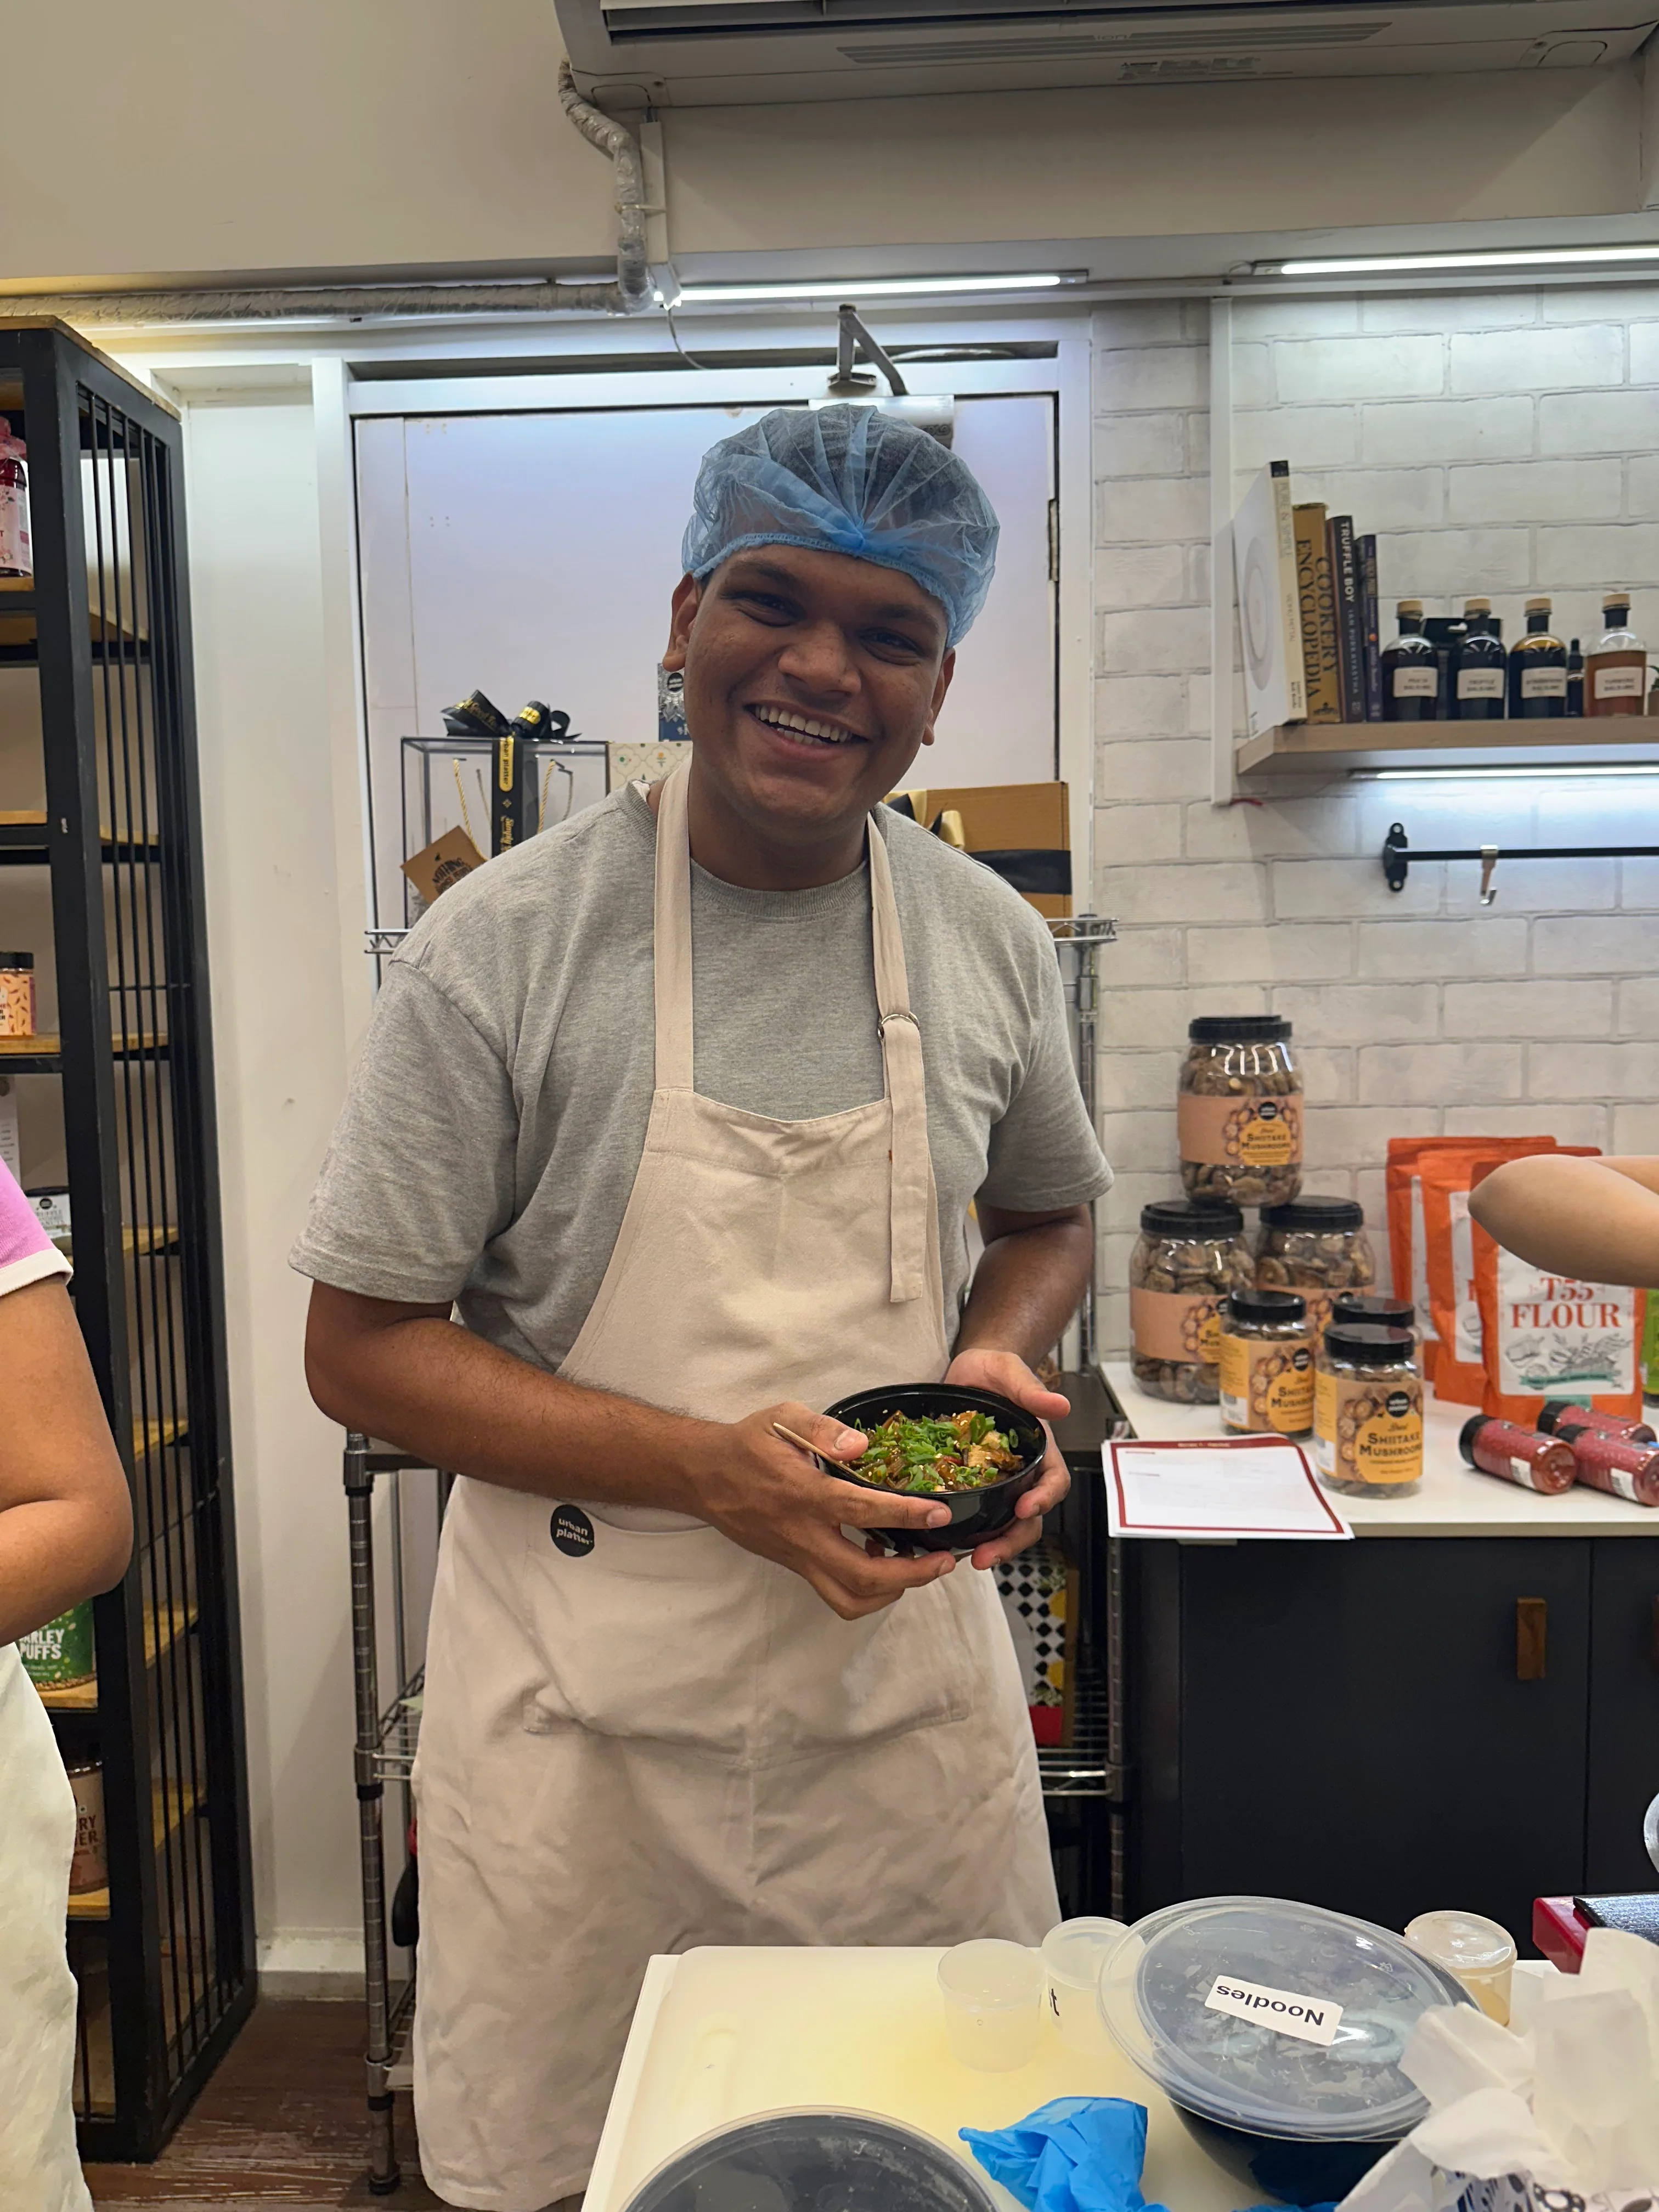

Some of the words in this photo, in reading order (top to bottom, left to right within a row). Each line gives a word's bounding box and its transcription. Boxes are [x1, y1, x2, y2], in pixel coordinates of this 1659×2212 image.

[1340, 522, 1353, 574] TRUFFLE
[1344, 574, 1355, 603] BOY
[1296, 539, 1321, 698] ENCYCLOPEDIA
[1316, 556, 1338, 673] COOKERY
[1540, 1277, 1594, 1302] T55
[1511, 1302, 1622, 1329] FLOUR
[1368, 1432, 1420, 1444] SHIITAKE
[556, 1528, 590, 1545] platter
[558, 1518, 588, 1537] urban
[19, 1628, 65, 1645] ARLEY
[19, 1643, 63, 1661] PUFFS
[1216, 1985, 1324, 2026] Noodles
